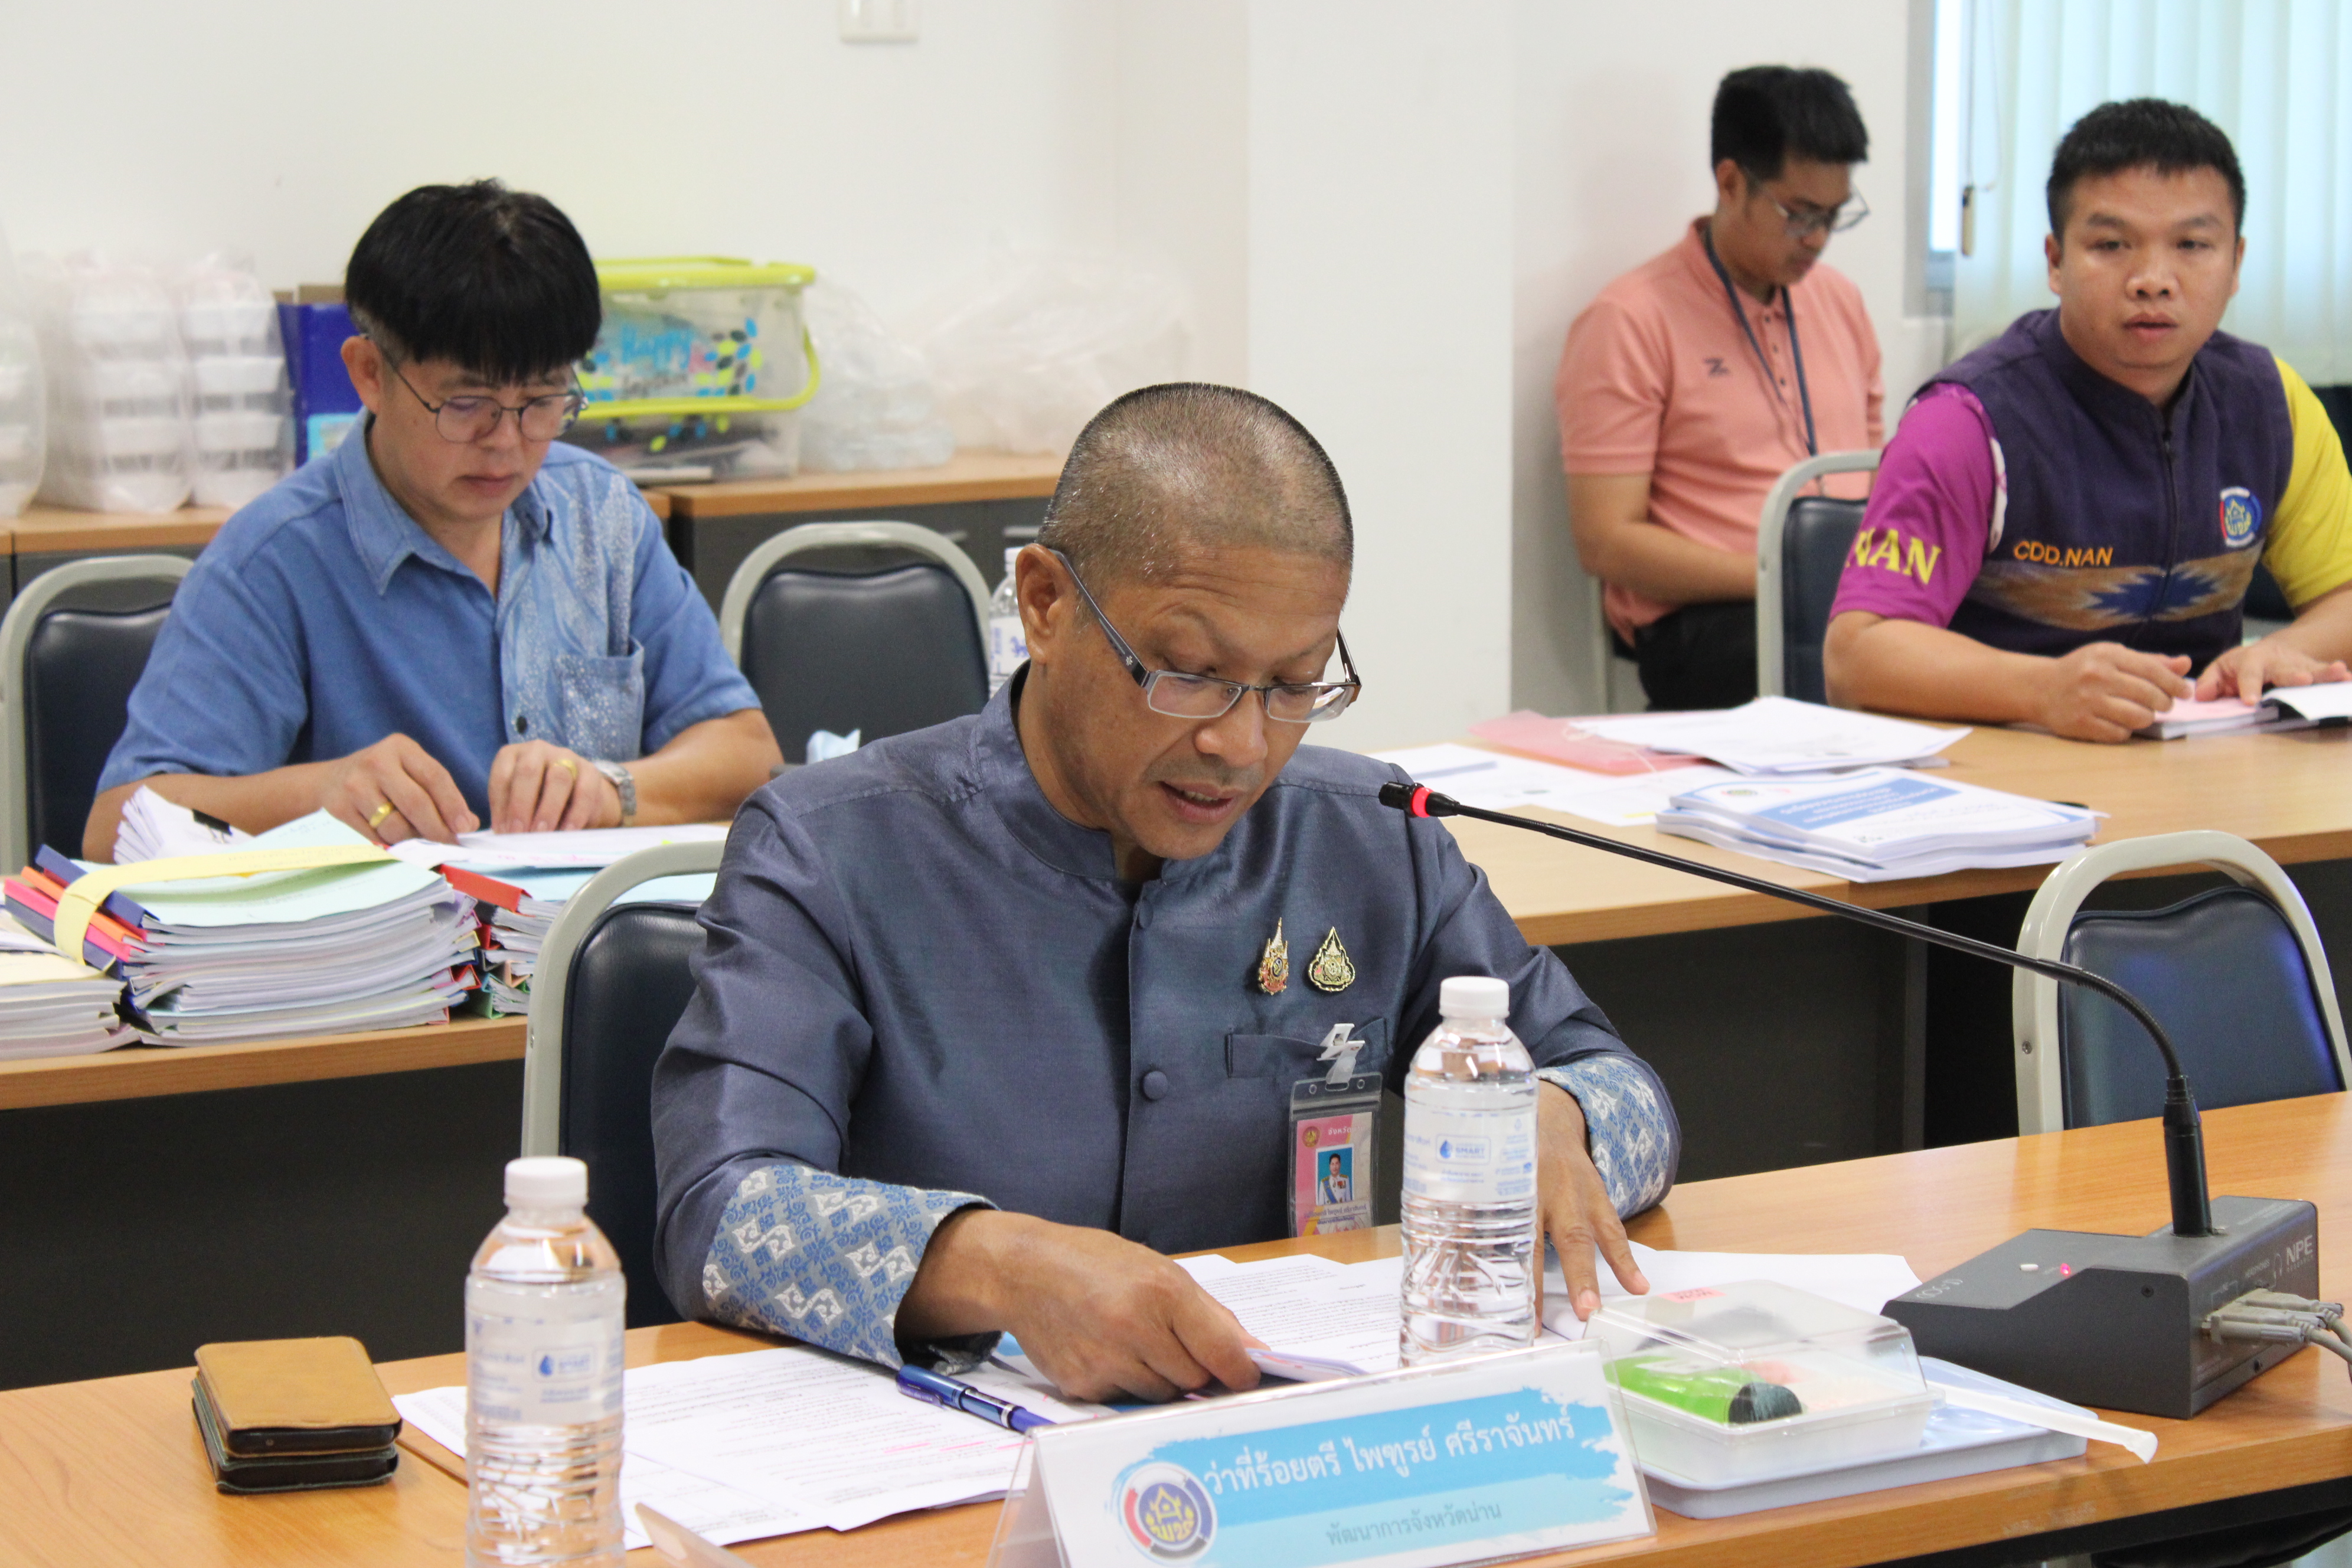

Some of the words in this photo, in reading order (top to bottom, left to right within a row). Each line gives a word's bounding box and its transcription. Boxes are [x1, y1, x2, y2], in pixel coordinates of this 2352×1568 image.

[1845, 527, 1942, 584] NAN
[2014, 540, 2113, 567] CDD.NAN
[2286, 1234, 2313, 1266] NPE
[1204, 1439, 1341, 1495] ว่าที่ร้อยตรี
[1342, 1424, 1436, 1477] ไพฑูรย์
[1445, 1404, 1575, 1457] ศรีราจันทร์
[1326, 1501, 1502, 1546] พัฒนาการจังหวัดน่าน
